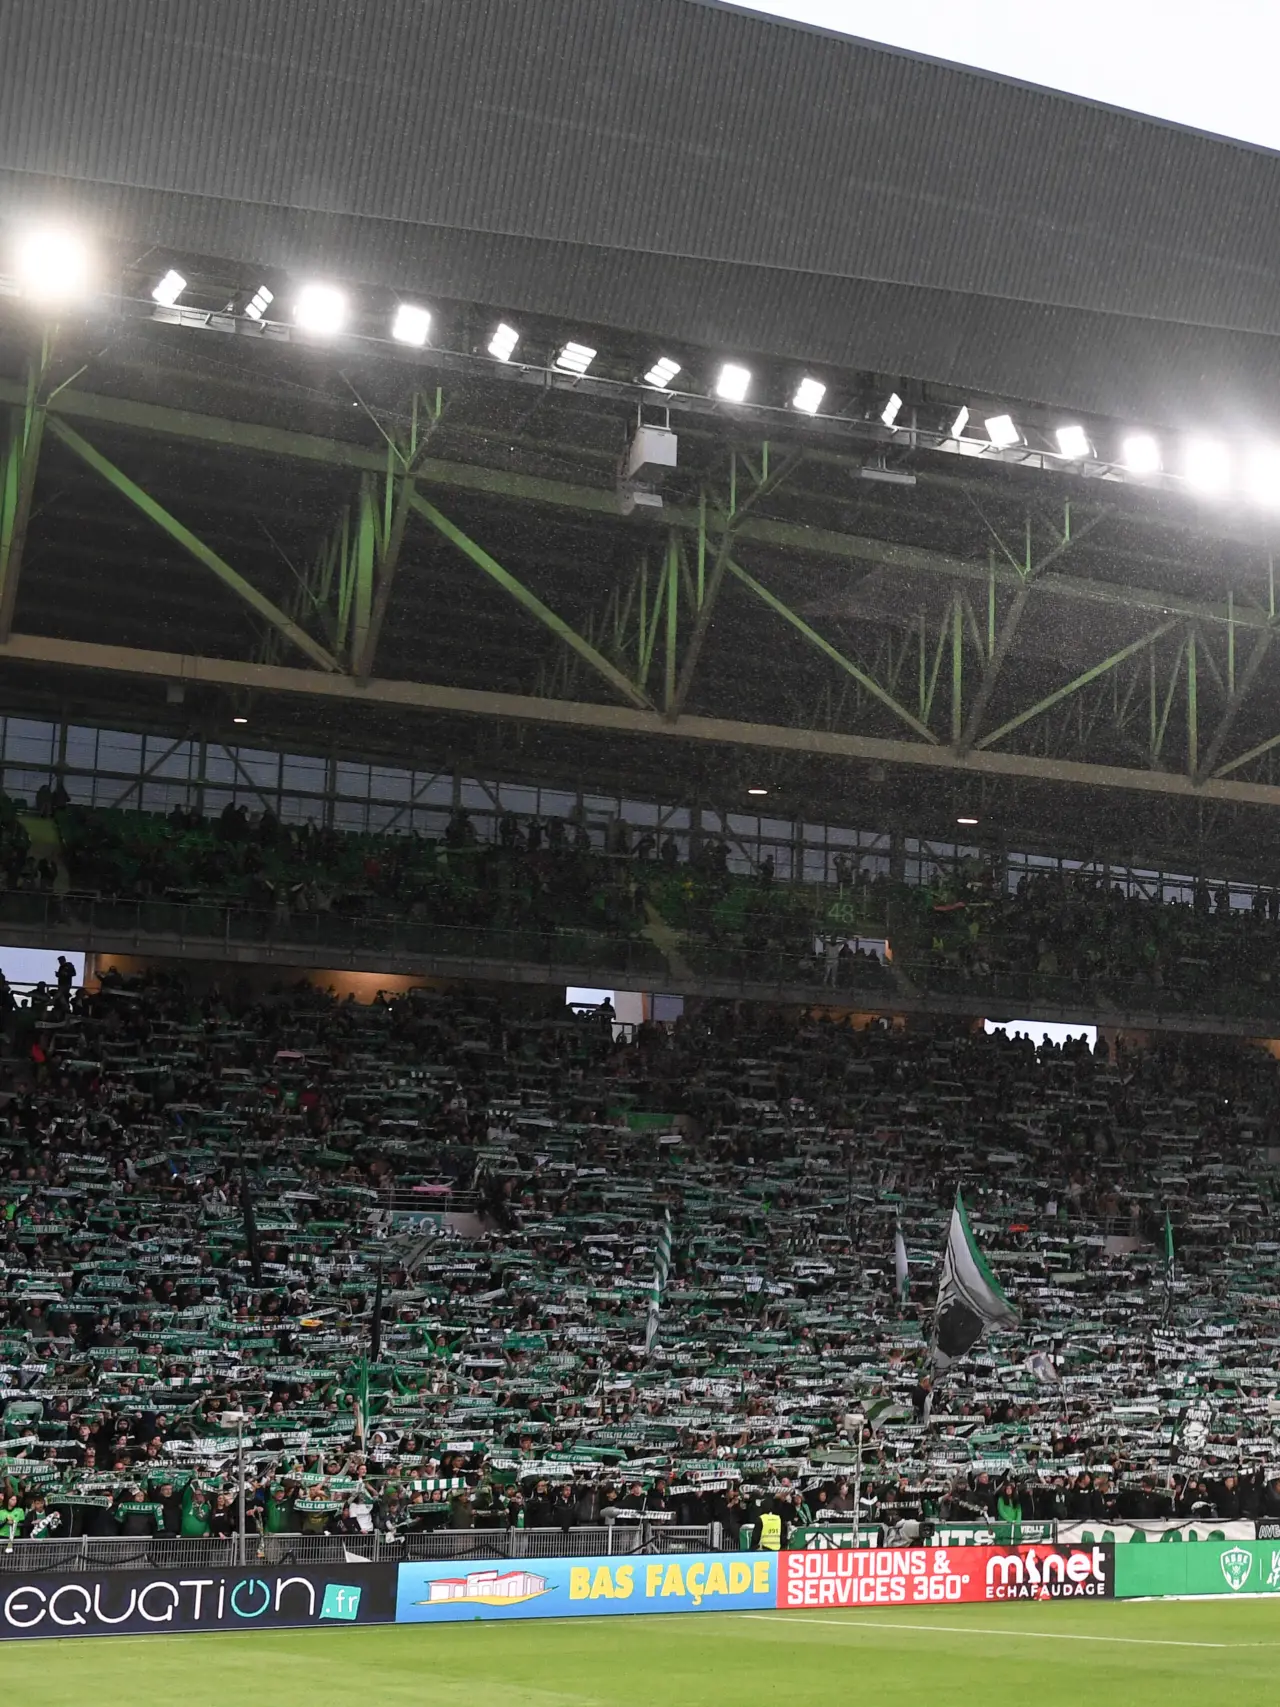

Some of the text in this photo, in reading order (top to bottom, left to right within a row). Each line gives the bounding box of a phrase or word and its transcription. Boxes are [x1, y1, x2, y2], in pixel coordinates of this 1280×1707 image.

[788, 1550, 951, 1578] SOLUTIONS &
[569, 1561, 770, 1606] BAS FAÇADE
[788, 1575, 970, 1604] SERVICES 360°
[985, 1583, 1105, 1598] ECHAFAUDAGE
